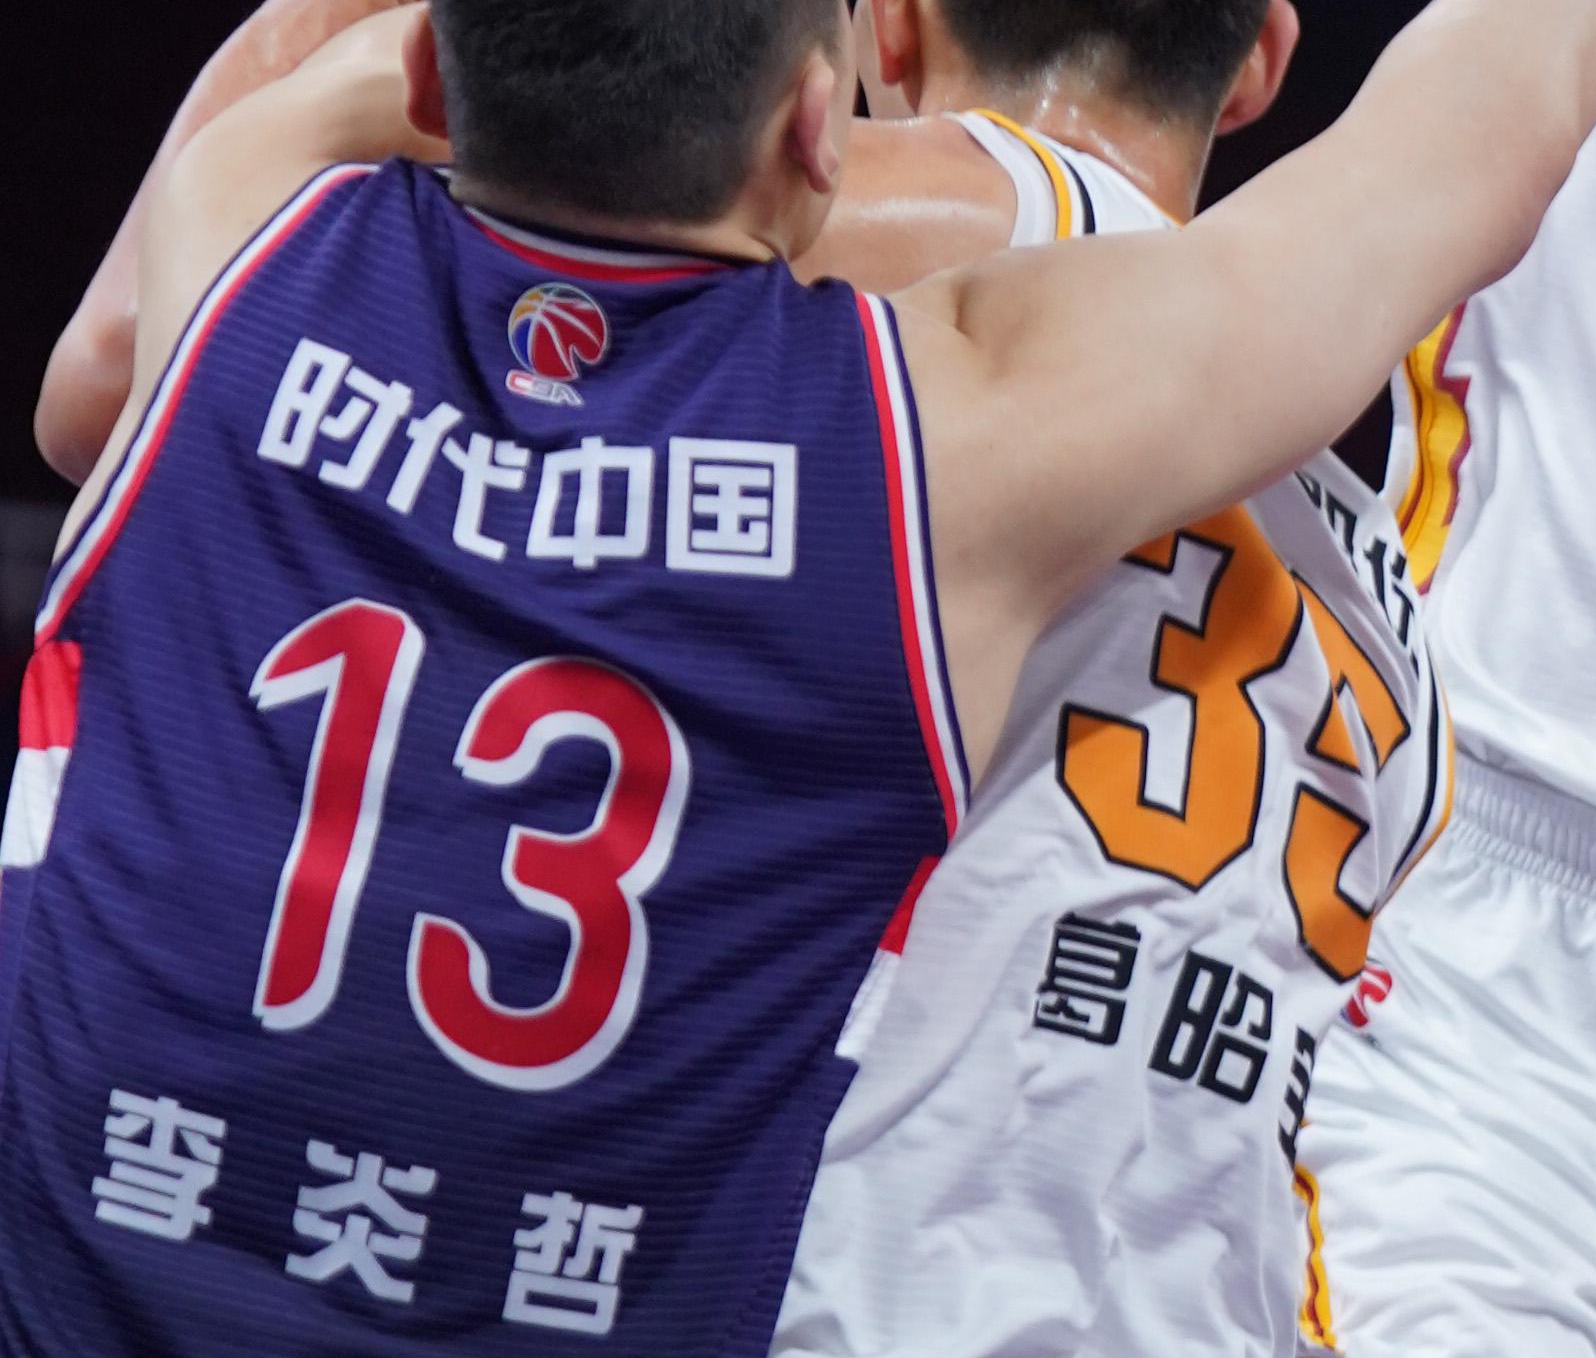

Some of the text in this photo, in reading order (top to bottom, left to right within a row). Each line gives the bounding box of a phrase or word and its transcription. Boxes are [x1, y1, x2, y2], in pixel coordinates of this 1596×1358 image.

[257, 337, 799, 579] 时代中国
[505, 369, 584, 408] CBA
[249, 596, 693, 1094] 13
[91, 1087, 645, 1336] 李炎哲
